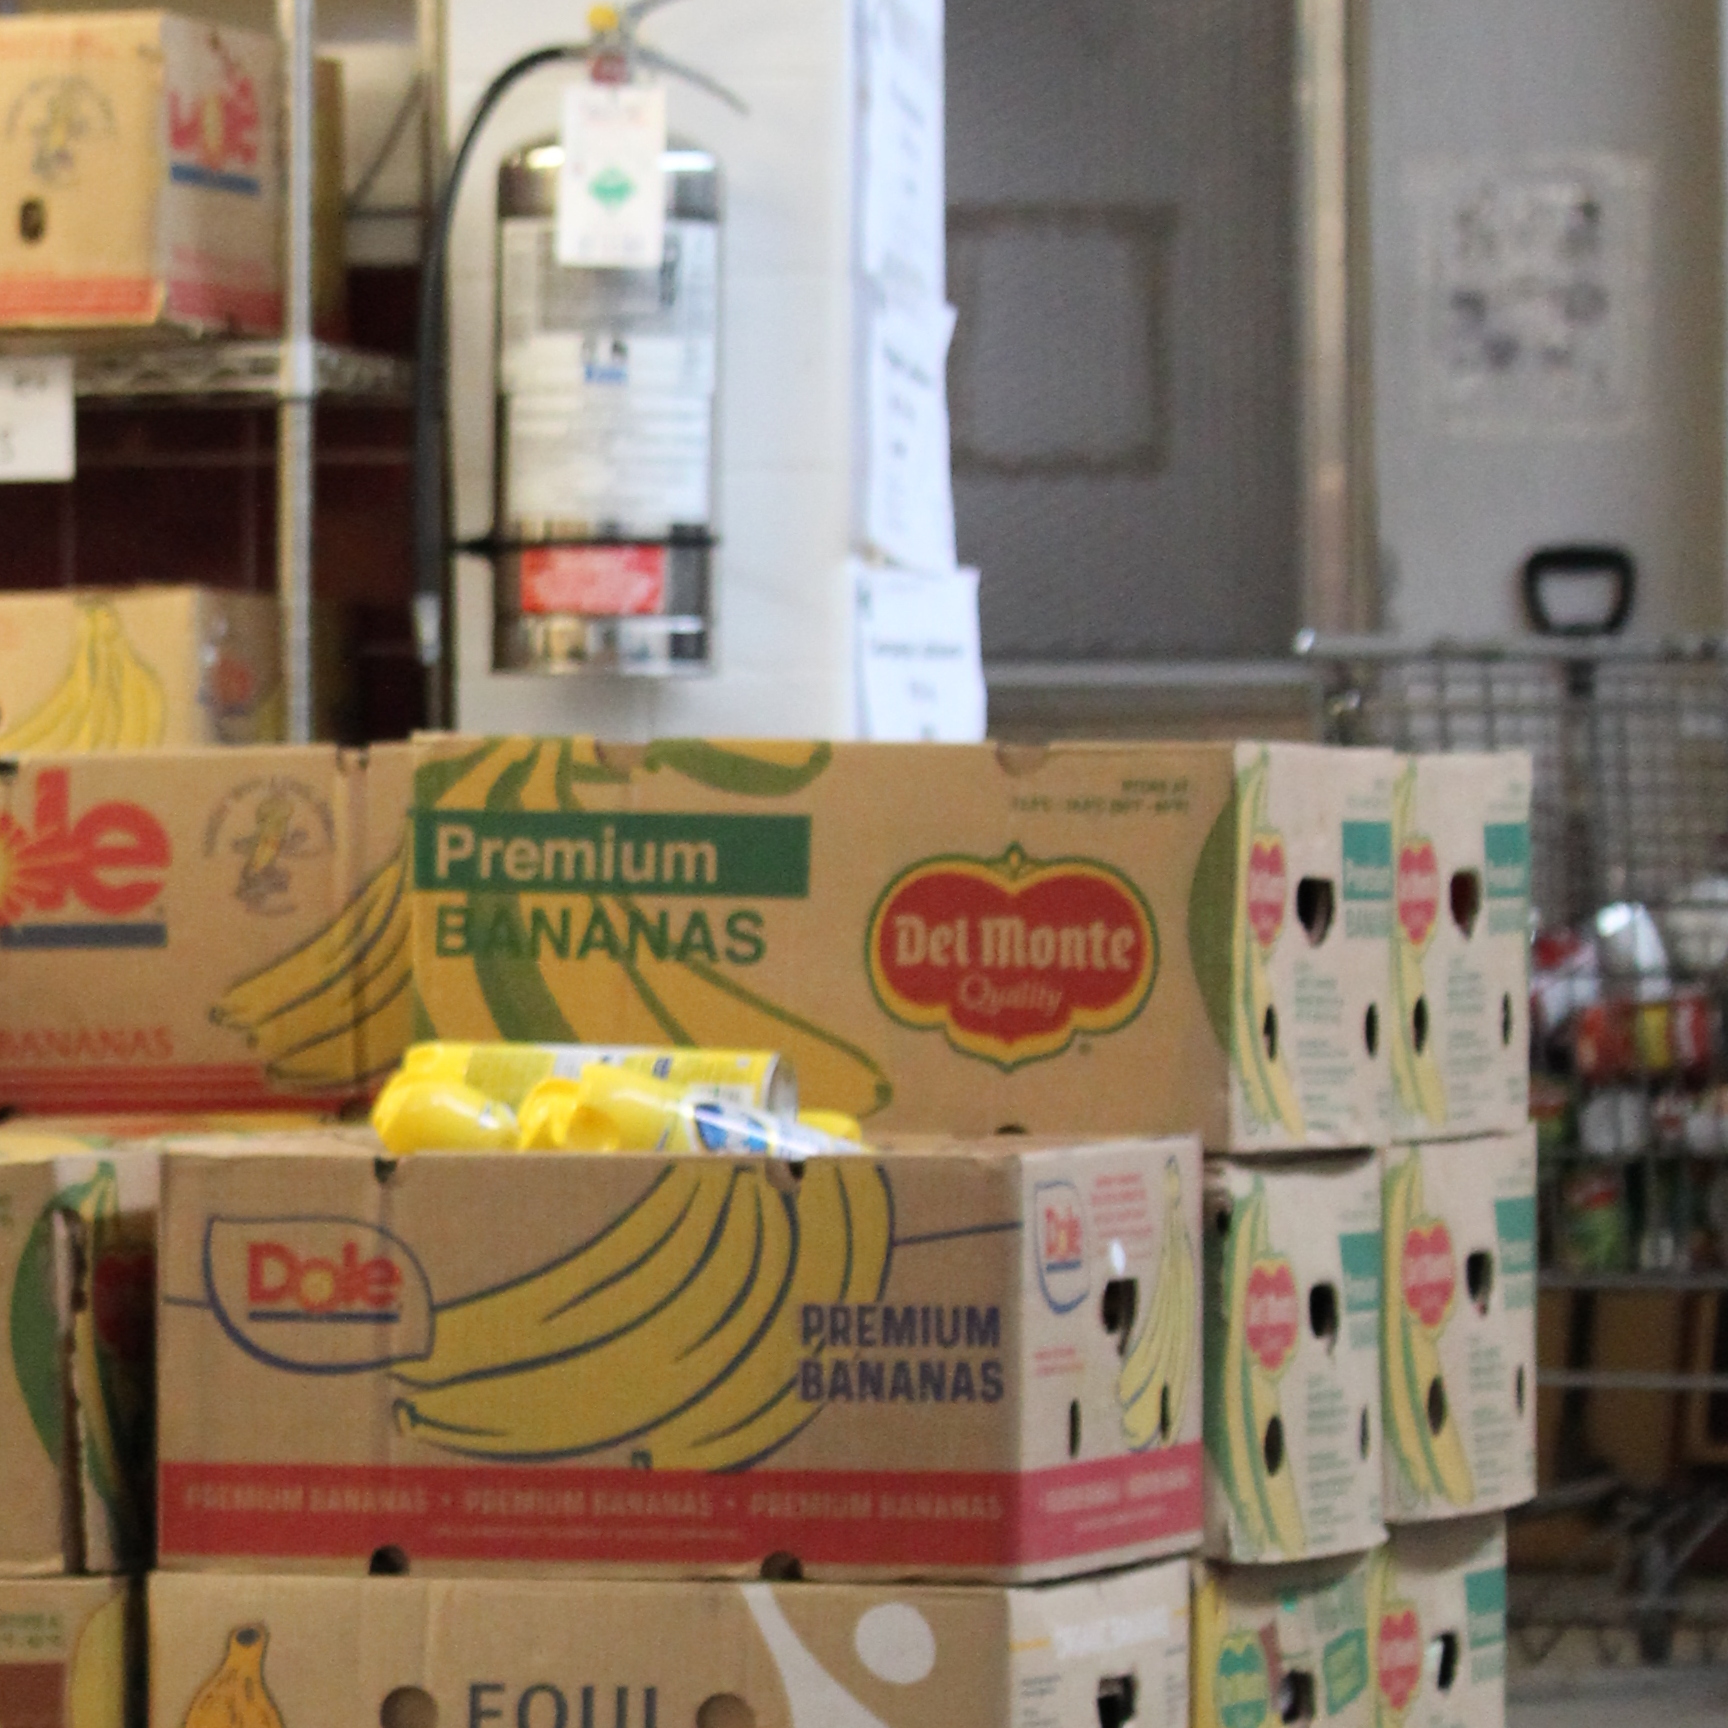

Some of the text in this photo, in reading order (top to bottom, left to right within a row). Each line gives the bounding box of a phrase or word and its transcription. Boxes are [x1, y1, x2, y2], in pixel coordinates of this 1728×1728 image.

[434, 825, 718, 885] Premium
[434, 904, 767, 966] BANANAS
[895, 913, 1136, 973] Del Monte
[959, 972, 1064, 1019] Quality
[247, 1240, 402, 1314] Dole
[800, 1303, 1001, 1350] PREMIUM
[798, 1359, 1005, 1405] BANANAS
